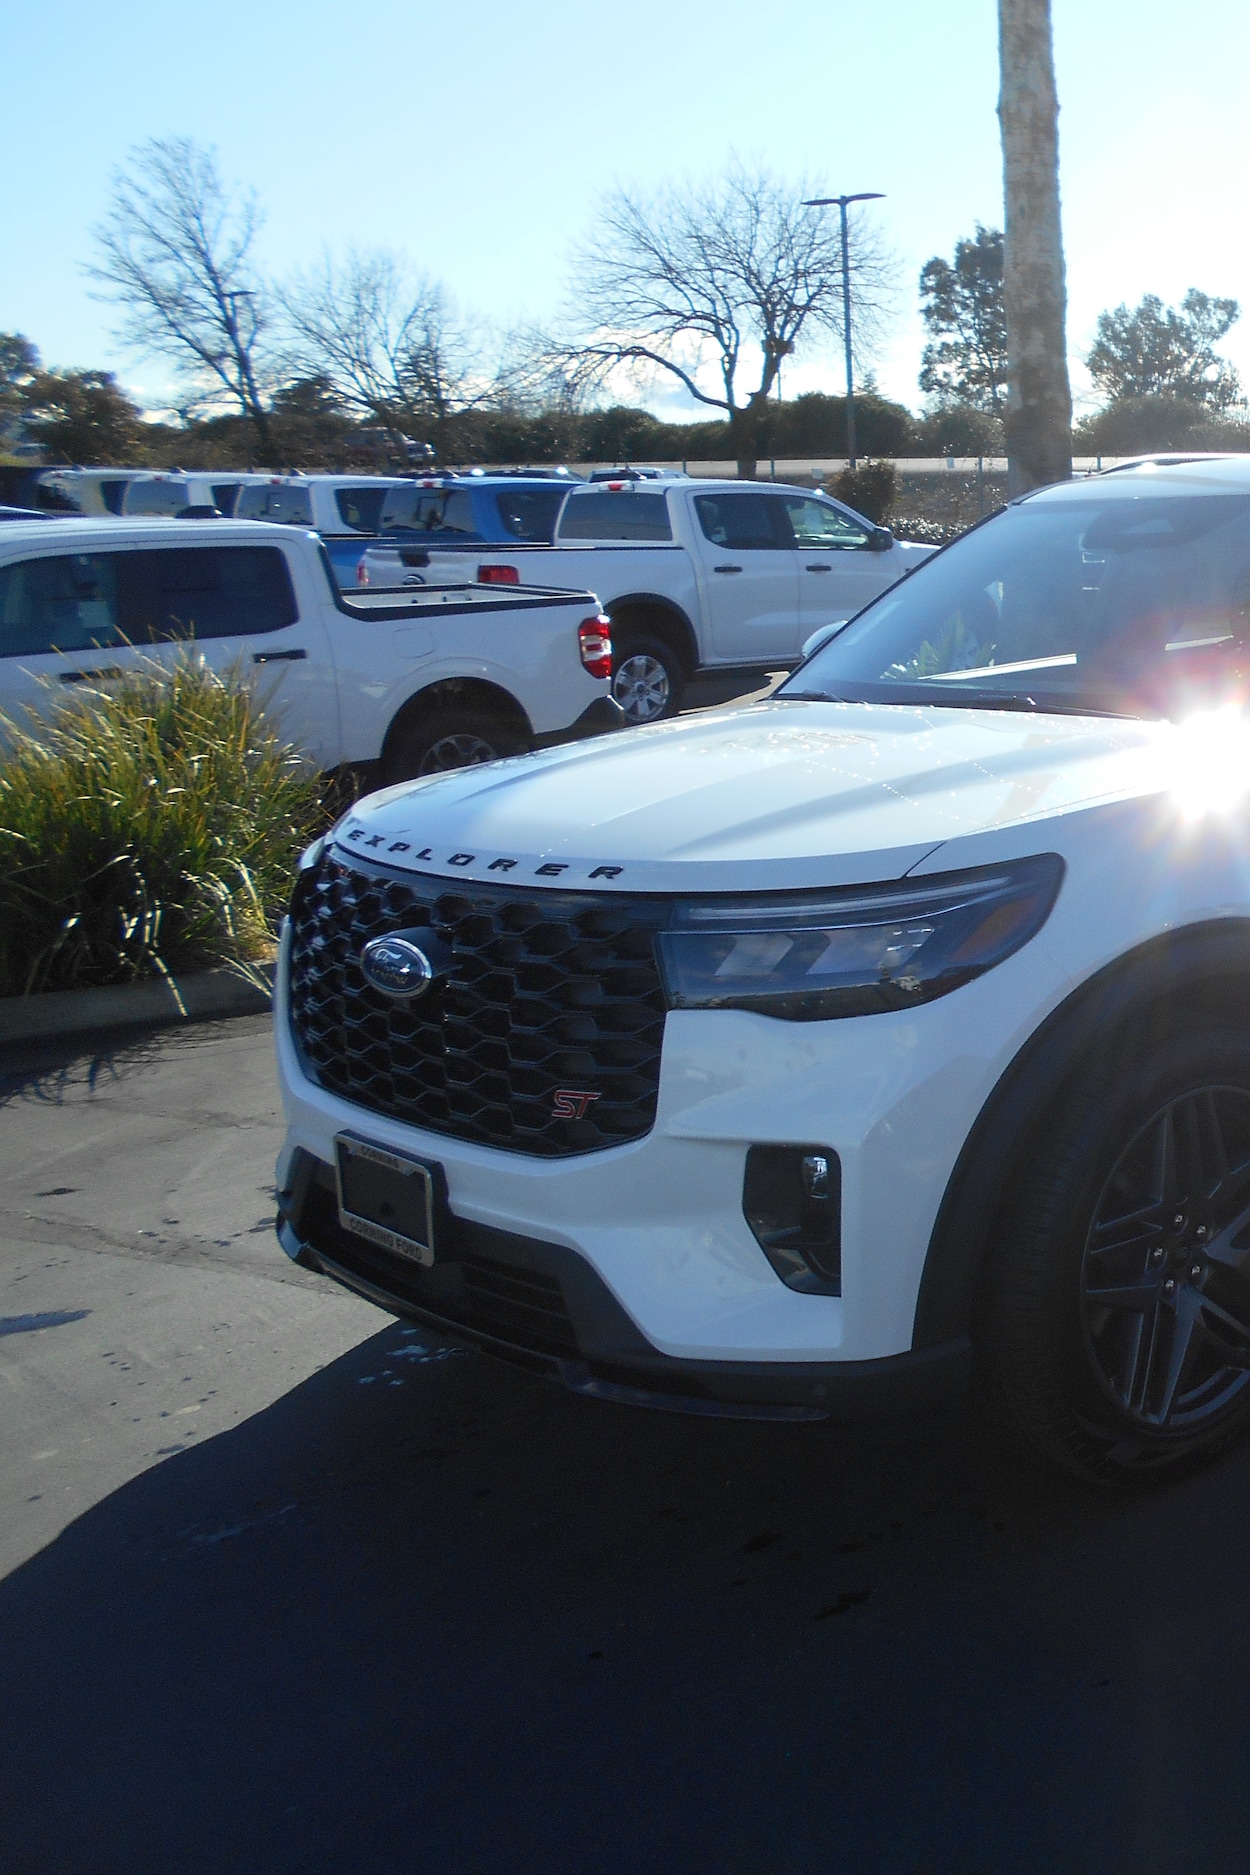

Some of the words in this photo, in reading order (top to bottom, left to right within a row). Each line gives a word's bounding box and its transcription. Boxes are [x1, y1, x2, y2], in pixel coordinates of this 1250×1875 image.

[346, 829, 624, 880] EXPLORER
[551, 1090, 602, 1119] ST
[395, 1238, 423, 1260] FORD
